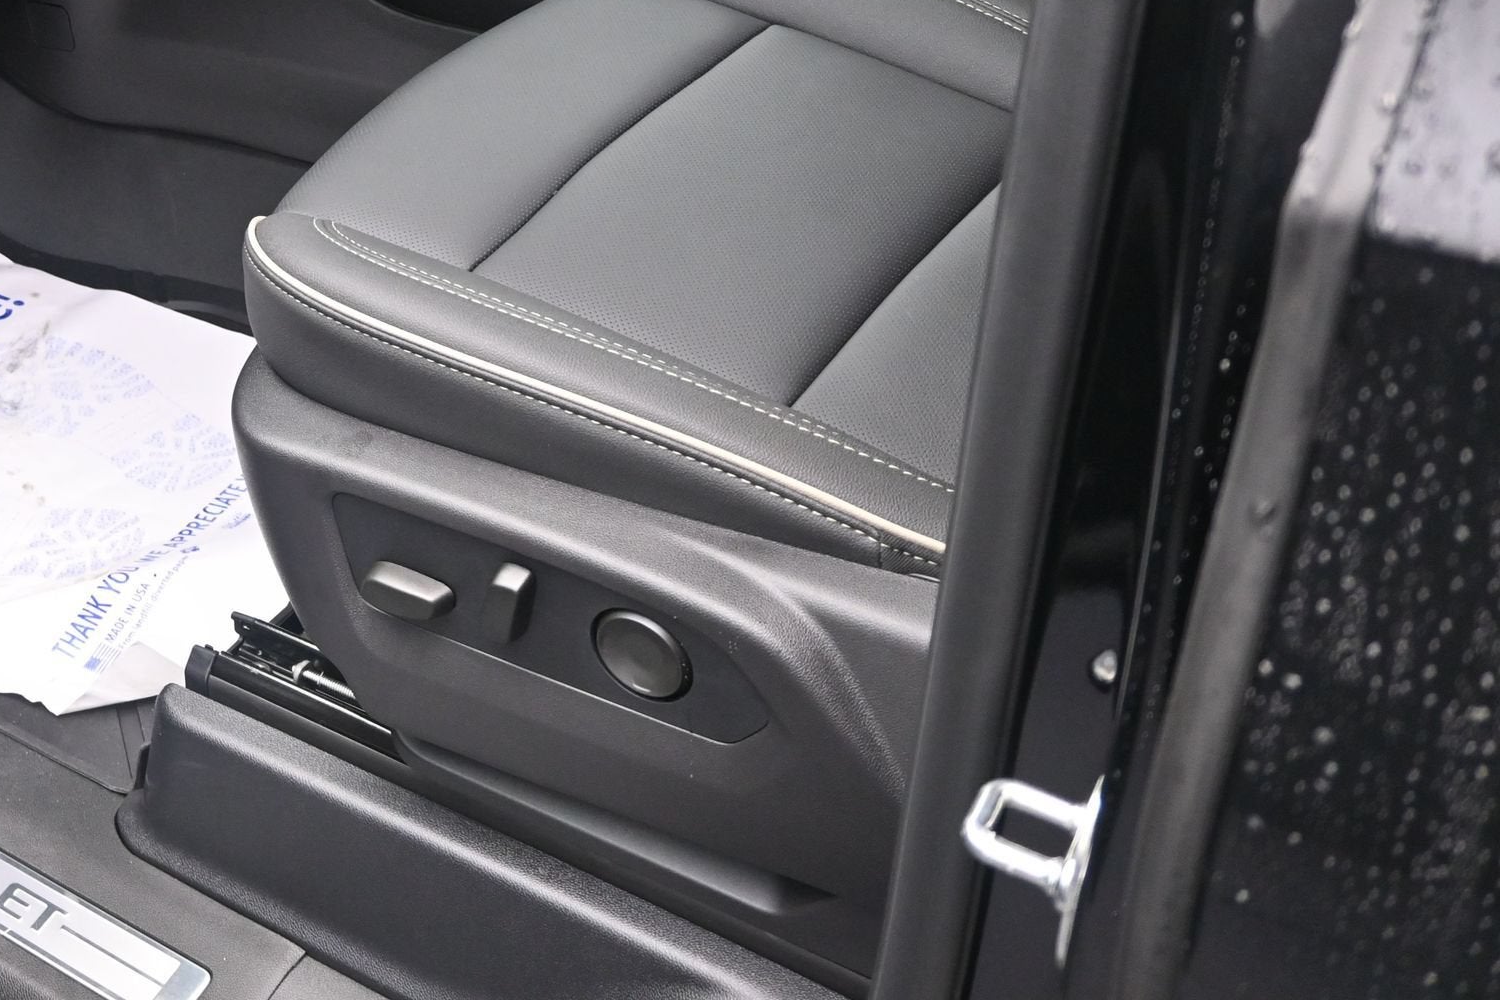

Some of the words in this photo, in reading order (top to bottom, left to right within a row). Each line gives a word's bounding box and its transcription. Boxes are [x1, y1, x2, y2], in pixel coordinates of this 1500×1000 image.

[52, 594, 112, 659] THANK
[164, 483, 248, 549] APPRECIATE
[105, 617, 128, 644] MADE
[124, 603, 137, 616] IN
[132, 582, 150, 605] USA
